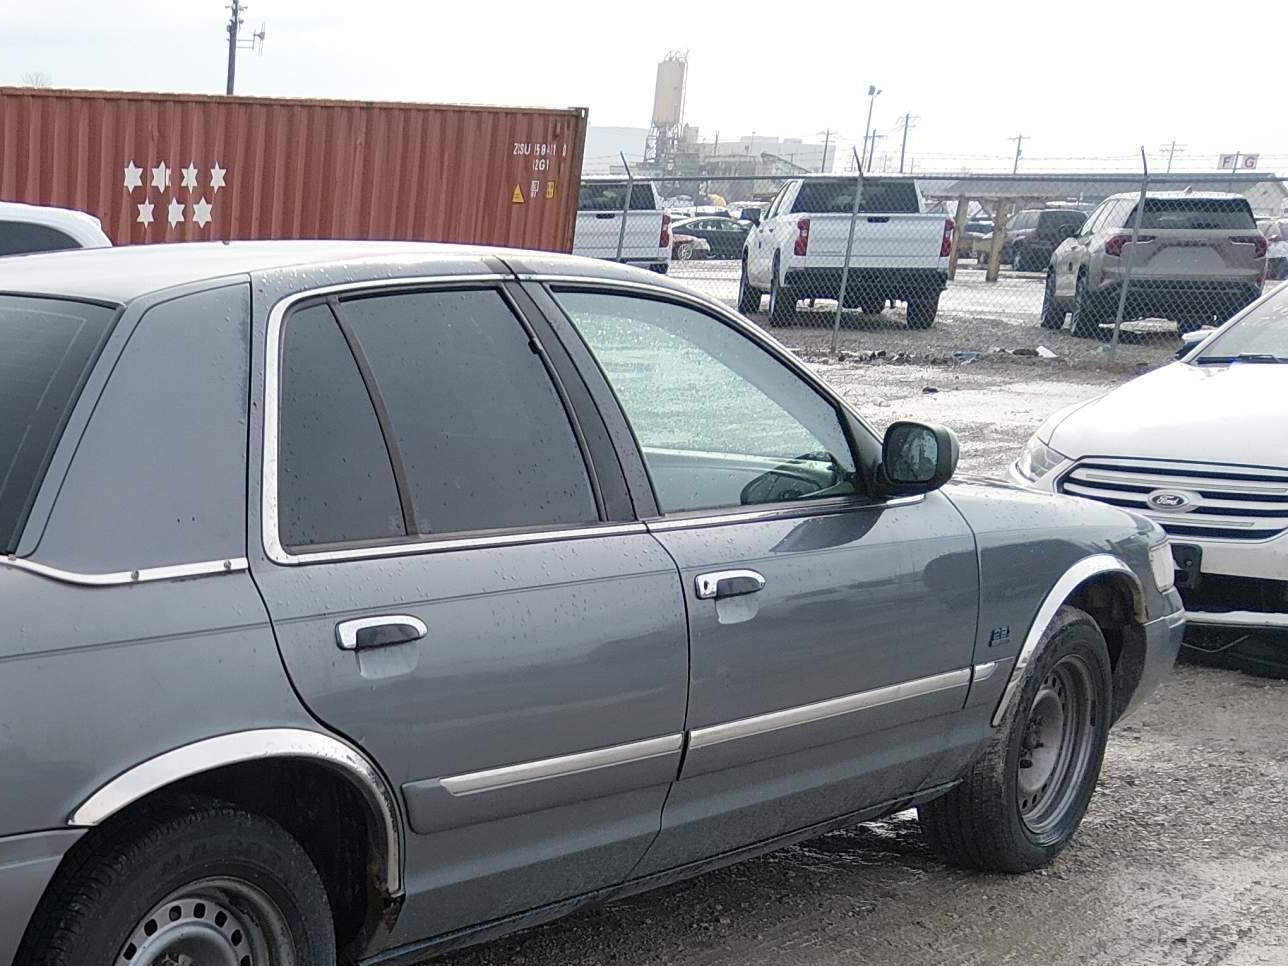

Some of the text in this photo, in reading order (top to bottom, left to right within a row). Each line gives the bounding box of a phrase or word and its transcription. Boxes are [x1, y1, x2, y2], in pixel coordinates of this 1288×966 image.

[1223, 157, 1255, 168] F G
[1156, 495, 1180, 505] Ford
